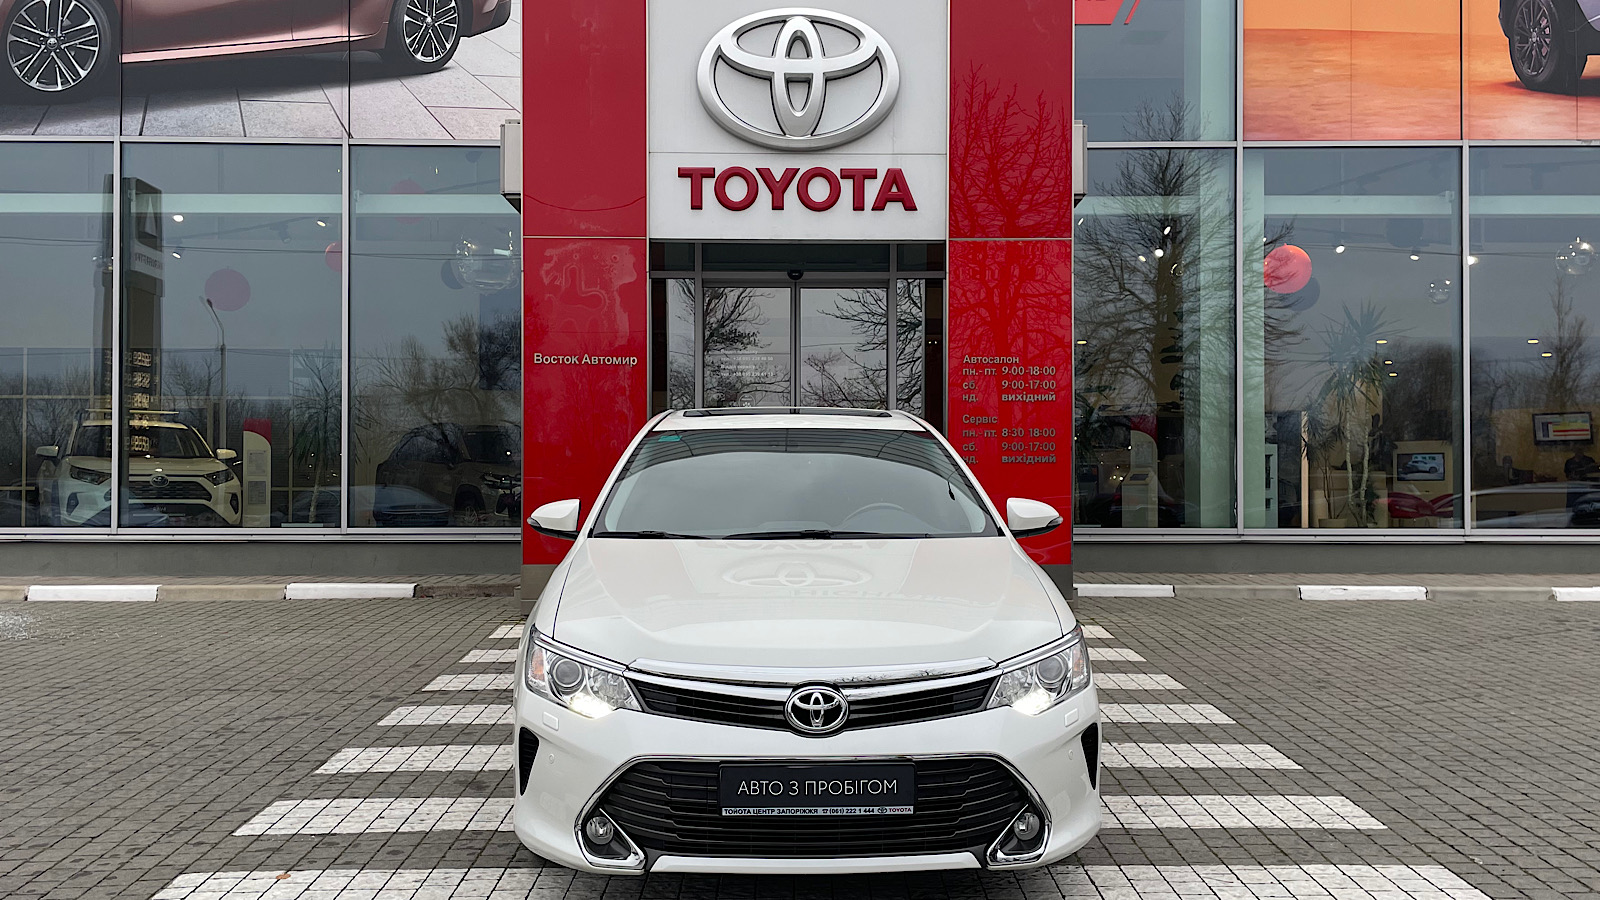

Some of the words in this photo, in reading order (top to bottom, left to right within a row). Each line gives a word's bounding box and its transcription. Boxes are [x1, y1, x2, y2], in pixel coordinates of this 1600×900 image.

[678, 166, 918, 212] TOYOTA
[534, 353, 579, 364] Восток
[582, 353, 638, 367] Автомир
[963, 355, 1019, 364] Автосалон
[962, 381, 978, 390] сб.
[962, 394, 979, 402] нд.
[1002, 391, 1056, 402] вихідний
[962, 442, 978, 451] сб.
[1002, 453, 1056, 464] вихідний
[737, 780, 783, 796] АВТО
[805, 779, 897, 795] ПРОБІГОМ
